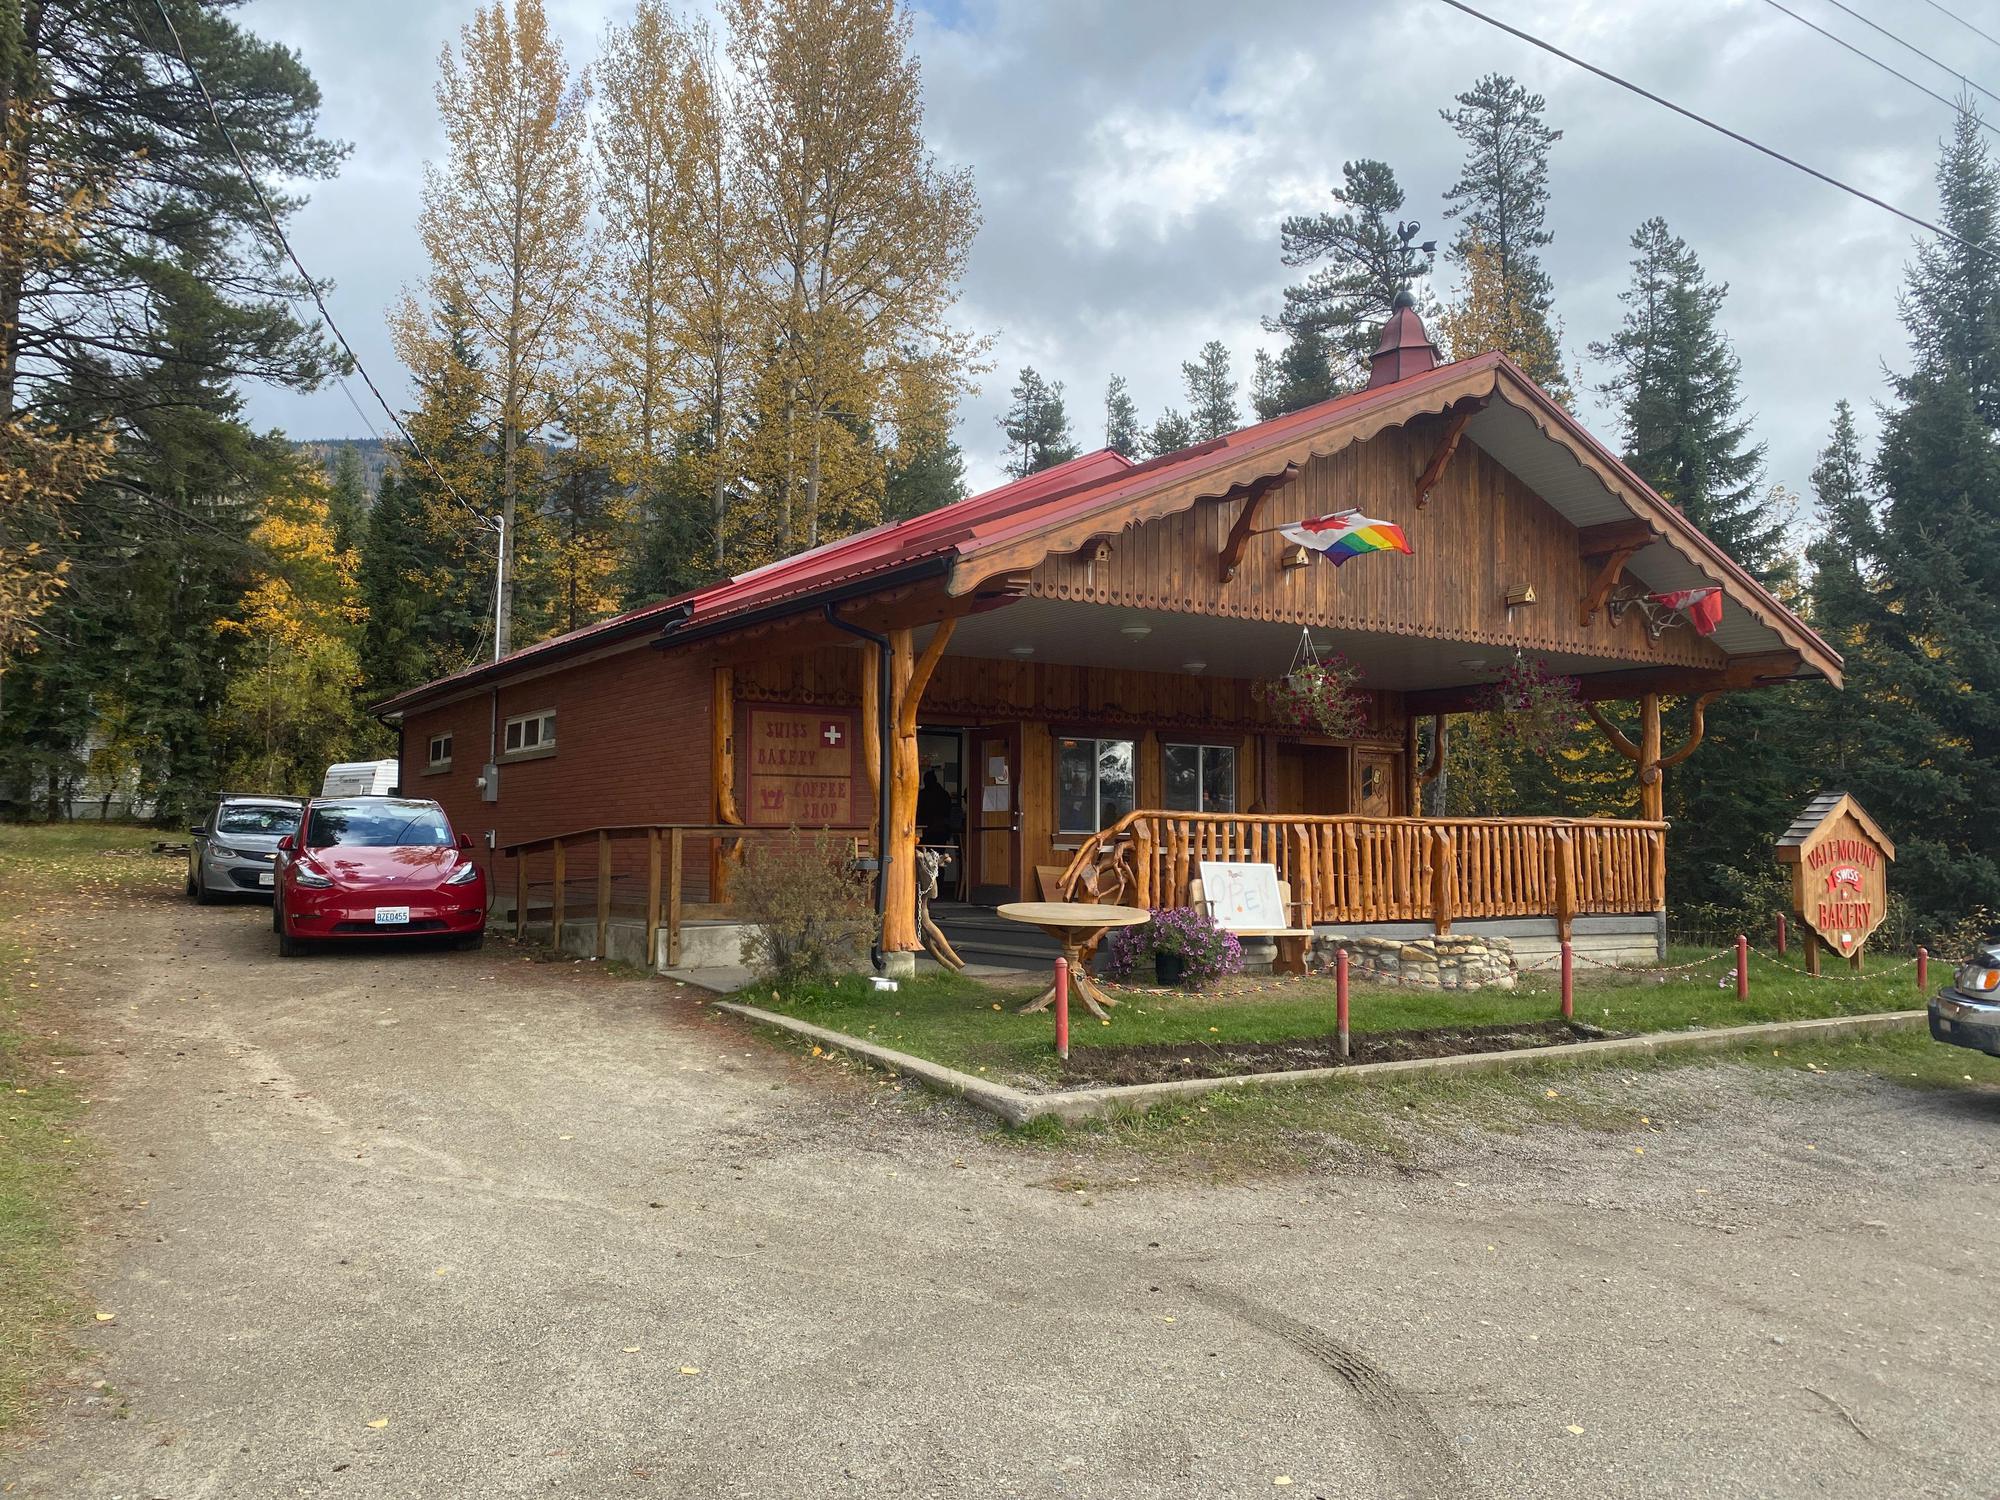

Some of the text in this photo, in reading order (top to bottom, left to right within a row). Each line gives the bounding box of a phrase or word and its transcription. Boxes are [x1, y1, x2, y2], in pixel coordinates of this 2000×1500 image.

[758, 748, 815, 765] BAKERY
[792, 781, 846, 798] COFFEE
[802, 802, 837, 818] SHOP
[1807, 839, 1879, 872] VALEMOUNT
[1835, 868, 1860, 883] SWISS
[1818, 903, 1871, 930] BAKERY
